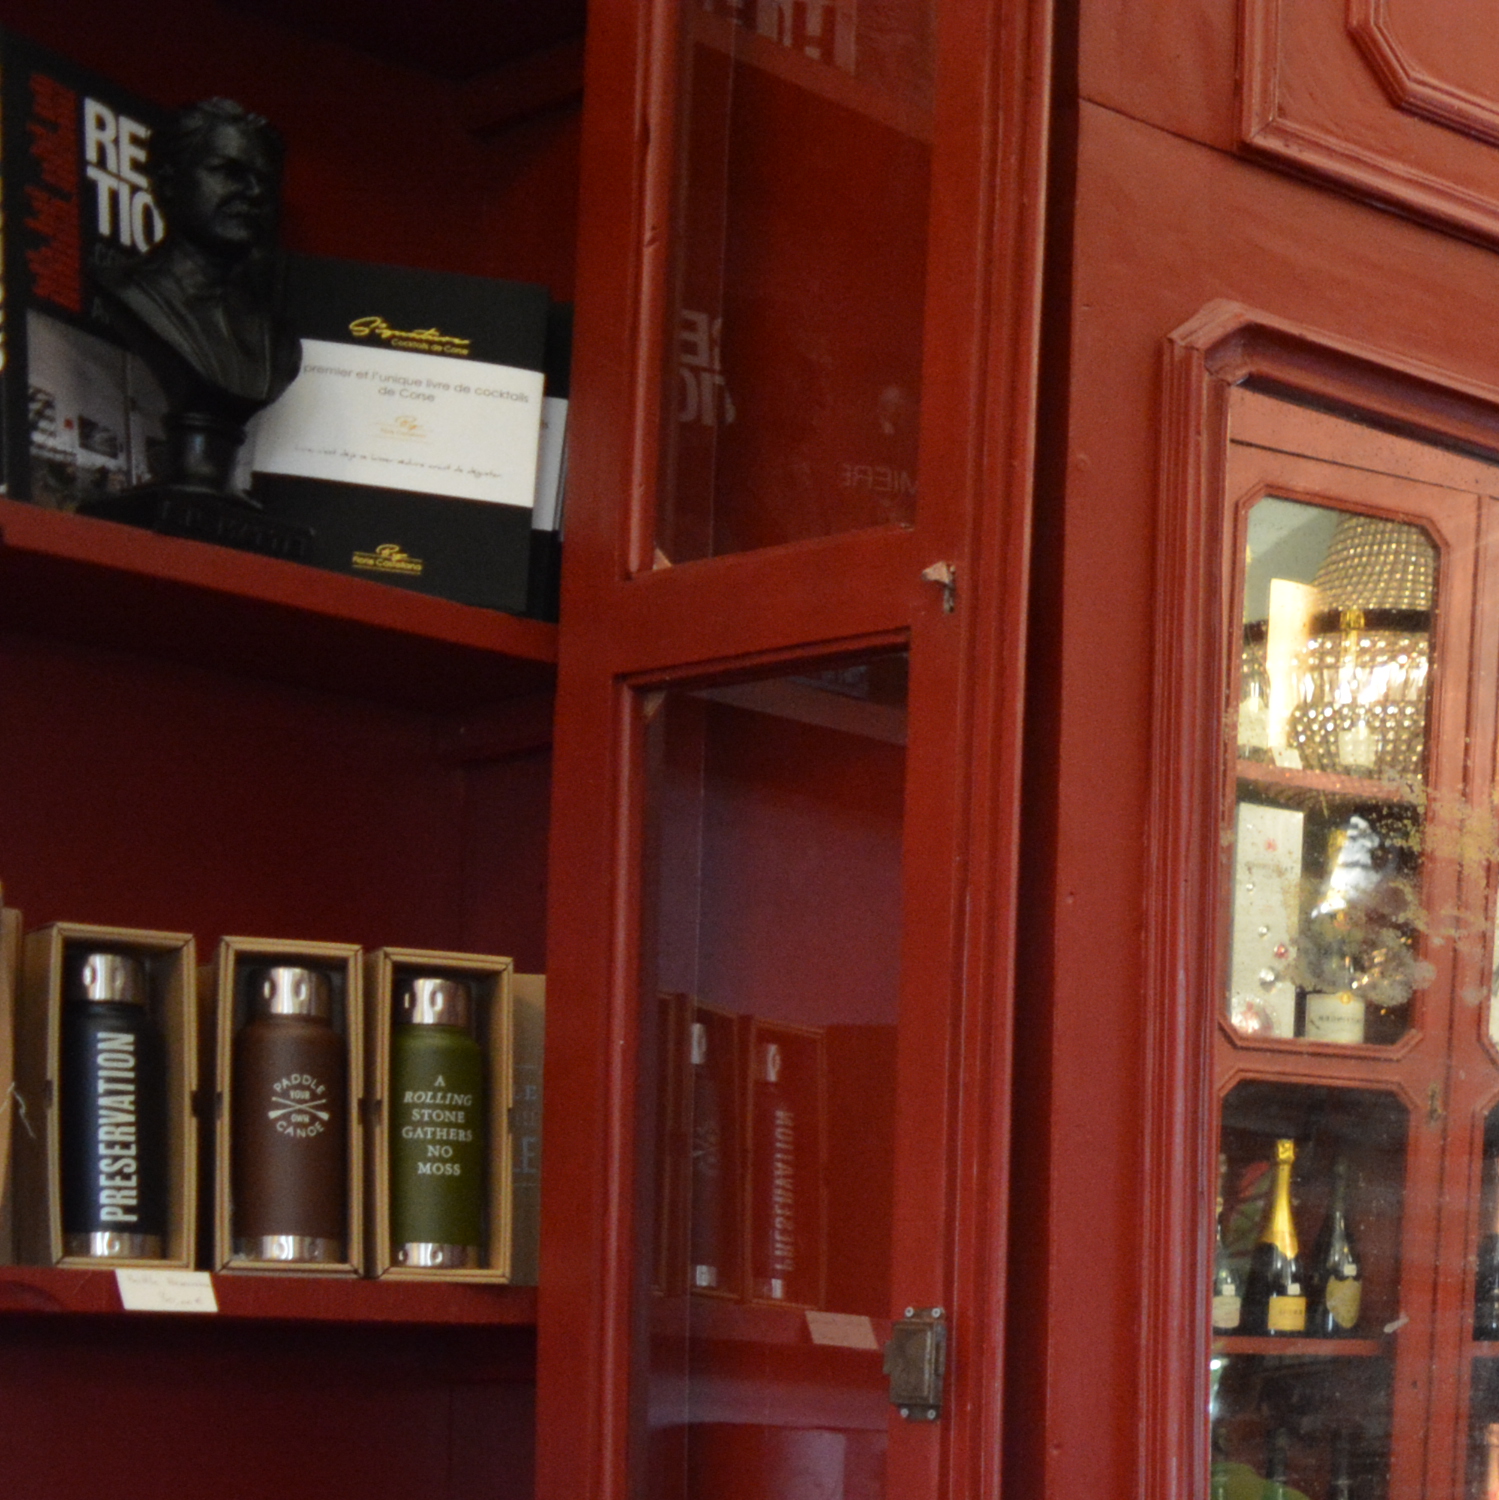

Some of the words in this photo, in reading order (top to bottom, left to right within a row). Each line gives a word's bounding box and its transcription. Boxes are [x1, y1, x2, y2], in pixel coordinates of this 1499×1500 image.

[303, 363, 353, 380] premier
[356, 369, 369, 380] et
[425, 377, 450, 392] livre
[454, 383, 471, 394] de
[474, 386, 529, 404] cocktails
[378, 385, 395, 396] de
[399, 387, 436, 402] Corse
[273, 1074, 326, 1095] PADDLE
[434, 1075, 445, 1087] A
[290, 1090, 310, 1099] YOUR
[404, 1091, 472, 1106] ROLLING
[291, 1114, 310, 1123] OWN
[411, 1109, 465, 1123] STONE
[97, 1032, 138, 1223] PRESERVATION
[276, 1121, 325, 1138] CANOE
[402, 1126, 473, 1142] GATHERS
[427, 1145, 453, 1158] NO
[417, 1162, 461, 1176] MOSS
